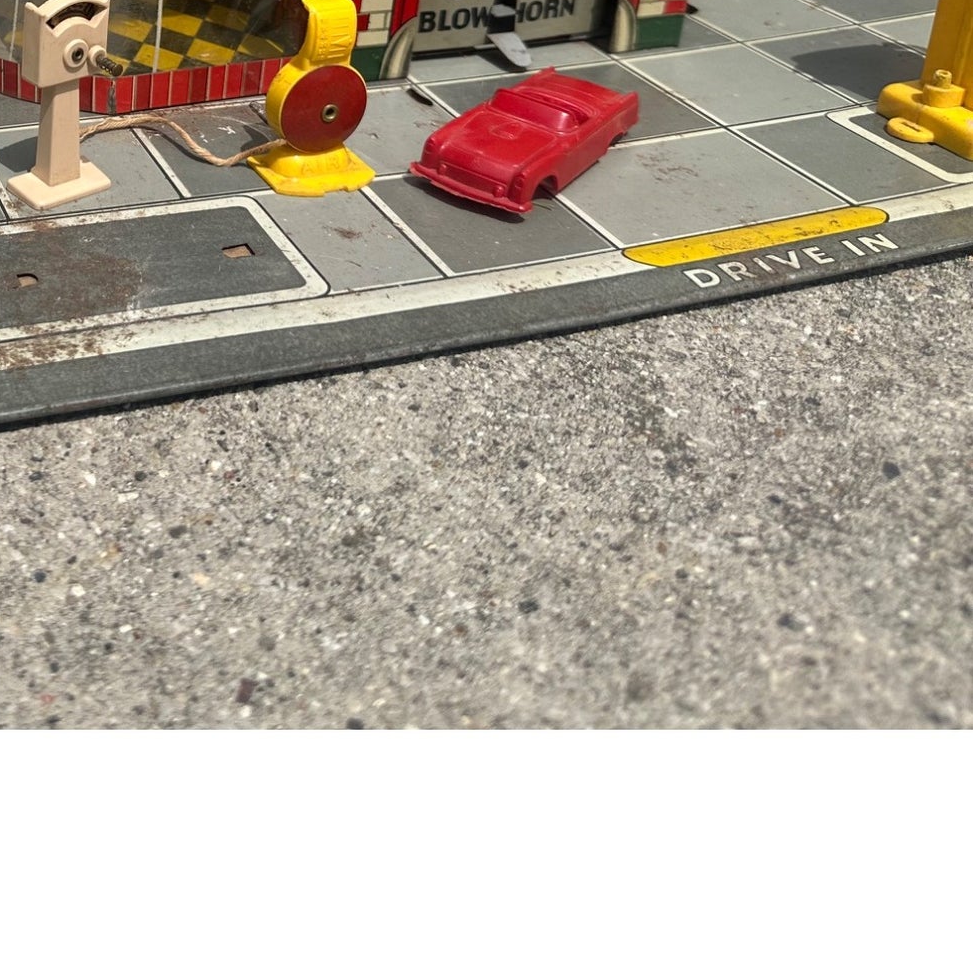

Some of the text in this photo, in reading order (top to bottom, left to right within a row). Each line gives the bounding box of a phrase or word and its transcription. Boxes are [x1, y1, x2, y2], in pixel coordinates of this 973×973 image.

[418, 5, 491, 34] BLOW
[683, 232, 899, 288] DRIVE IN
